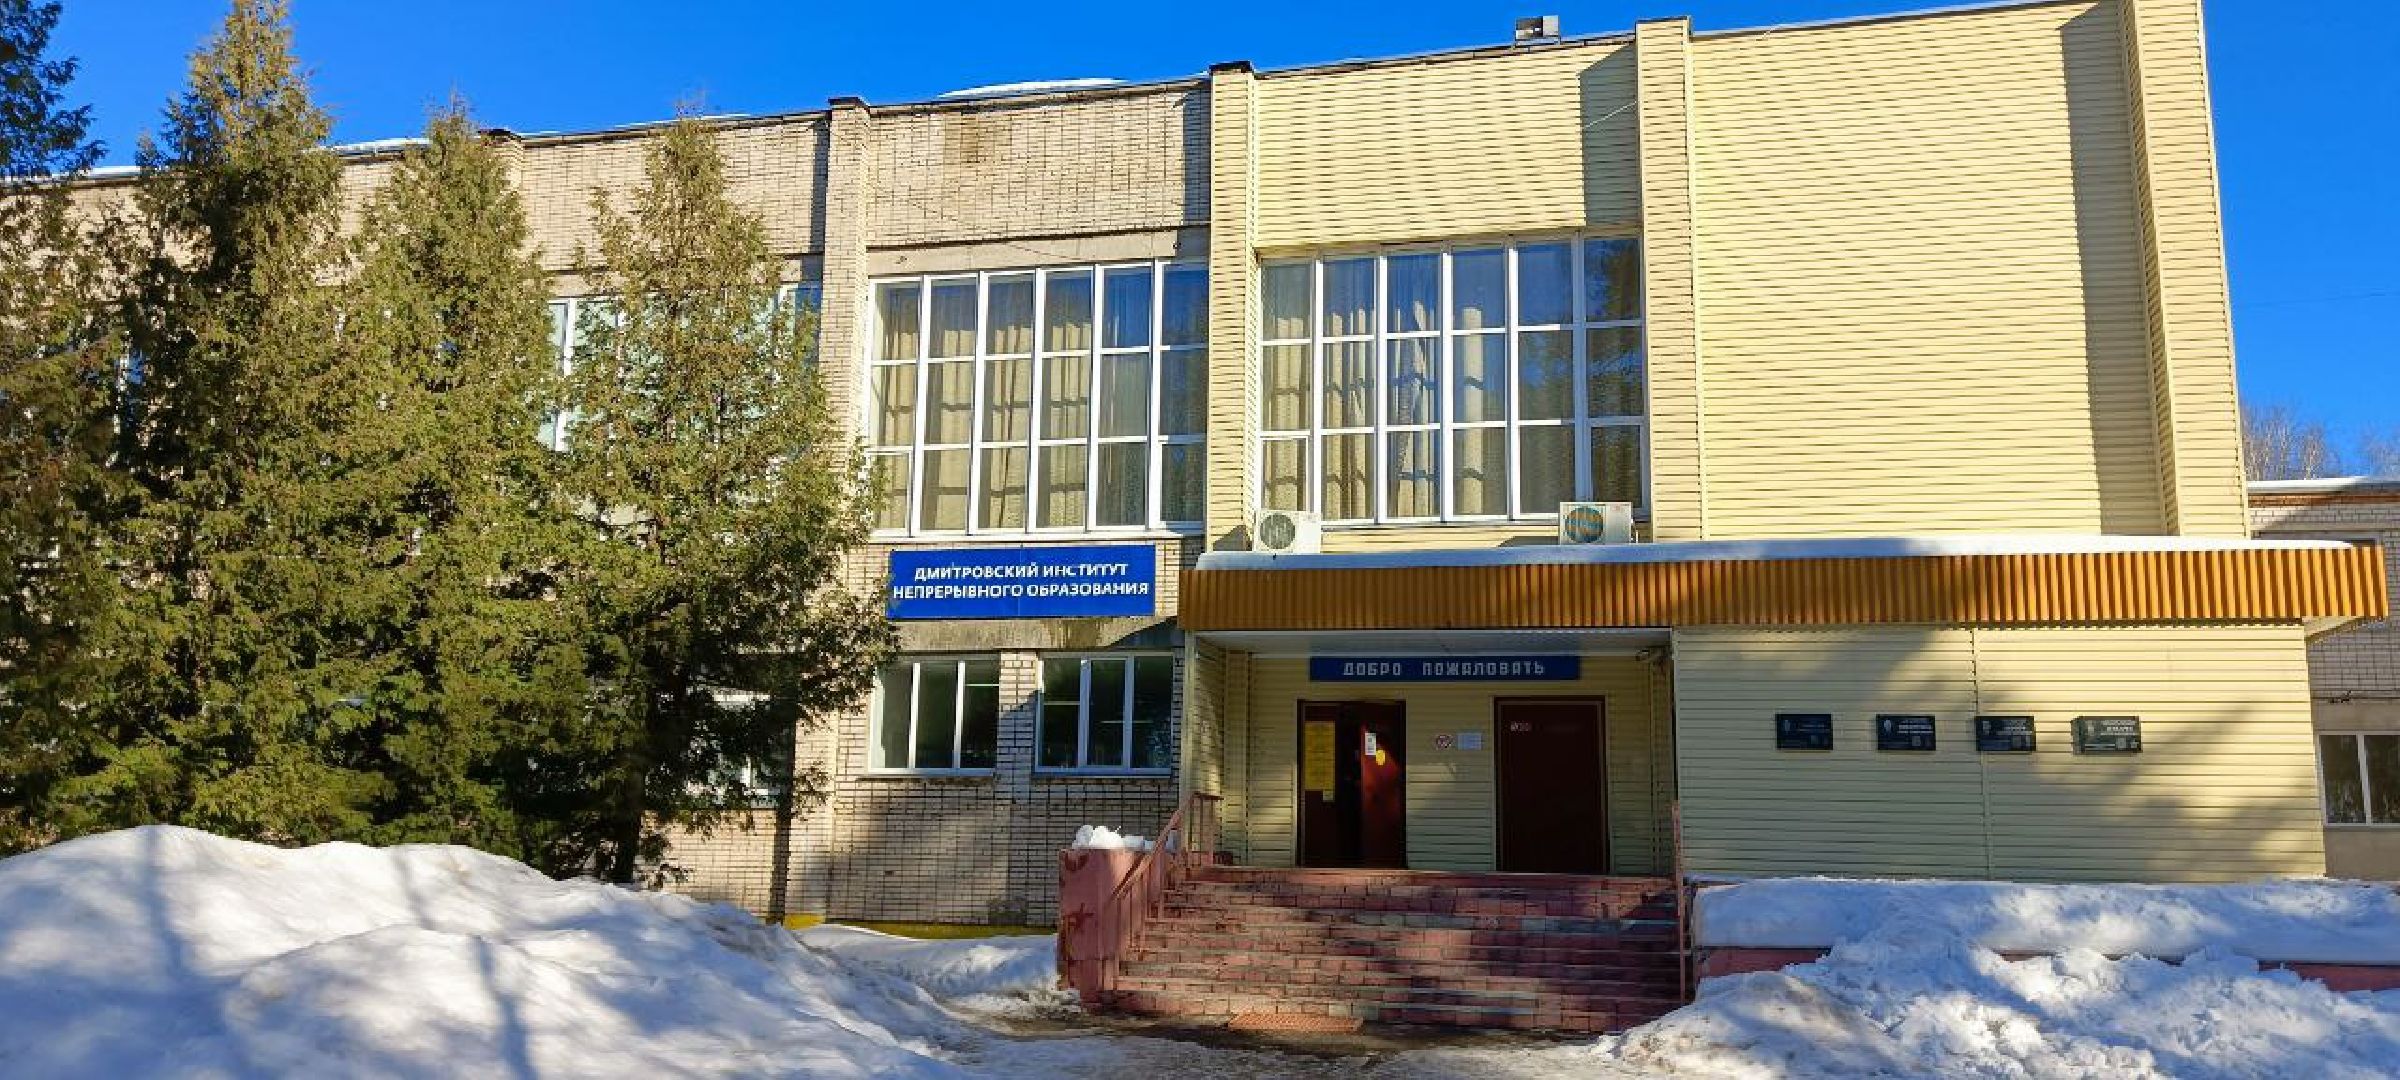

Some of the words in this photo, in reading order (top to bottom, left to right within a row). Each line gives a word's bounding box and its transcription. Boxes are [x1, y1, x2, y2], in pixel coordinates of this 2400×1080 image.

[914, 561, 1039, 581] ДМИТРОВСКИЙ
[1043, 562, 1129, 577] ИНСТИТУТ
[892, 583, 1023, 599] НЕПРЕРЫВНОГО
[1026, 581, 1149, 597] ОБРАЗОВАНИЯ
[1343, 662, 1402, 676] ДОБРО
[1422, 660, 1545, 676] ПОЖАЛОВАТЬ
